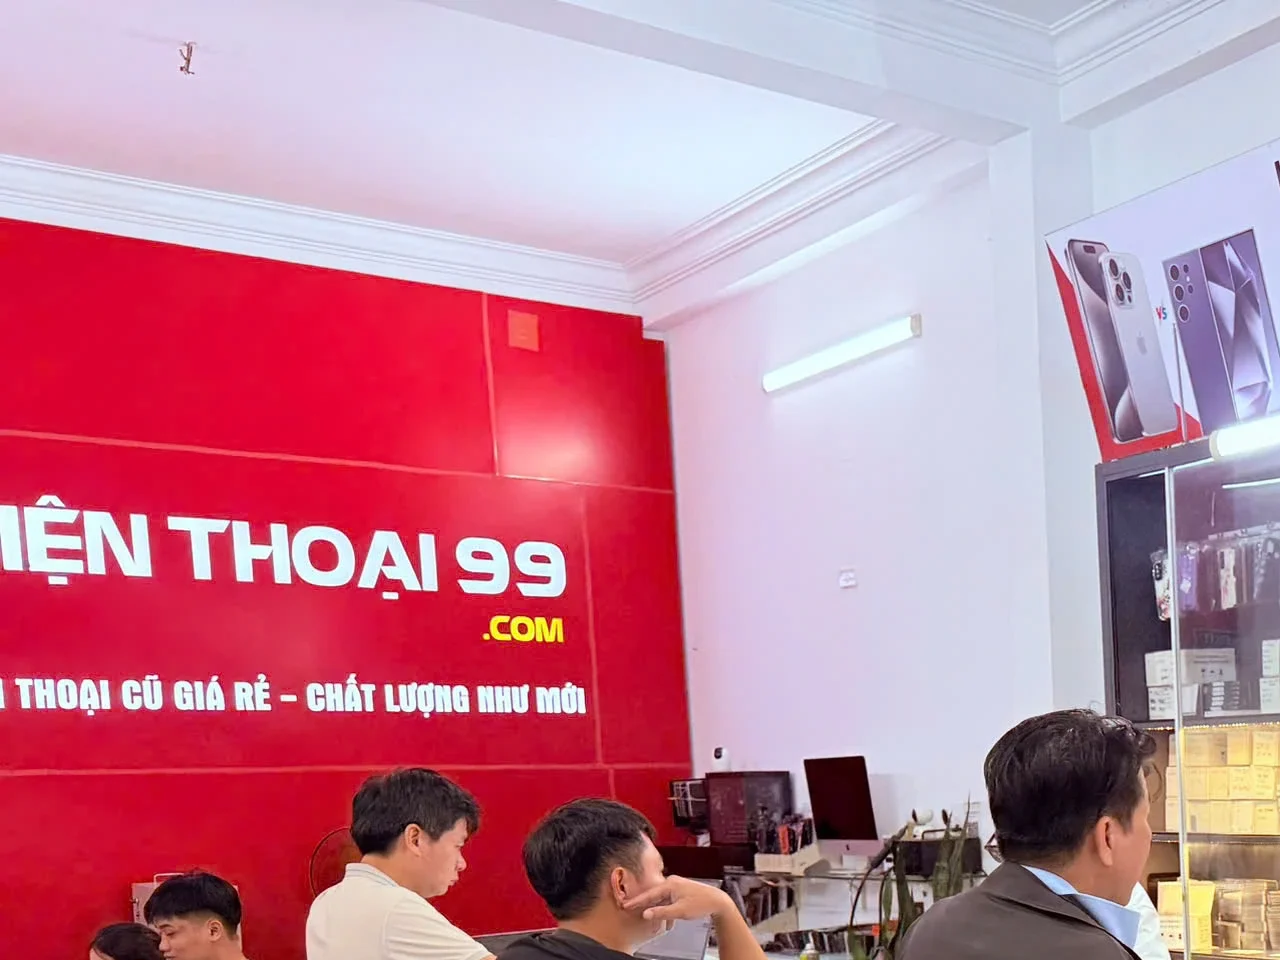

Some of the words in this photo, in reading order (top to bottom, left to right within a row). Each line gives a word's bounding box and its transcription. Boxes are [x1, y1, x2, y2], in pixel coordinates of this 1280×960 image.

[166, 515, 439, 600] THOẠI
[455, 536, 568, 598] 99
[482, 614, 565, 643] .COM
[15, 677, 112, 716] THOẠI
[121, 674, 164, 711] CŨ
[173, 675, 226, 712] GIÁ
[233, 673, 272, 712] RẺ
[306, 673, 377, 712] CHẤT
[384, 681, 470, 719] LƯỢNG
[476, 684, 530, 713] NHƯ
[535, 681, 587, 714] MỚI
